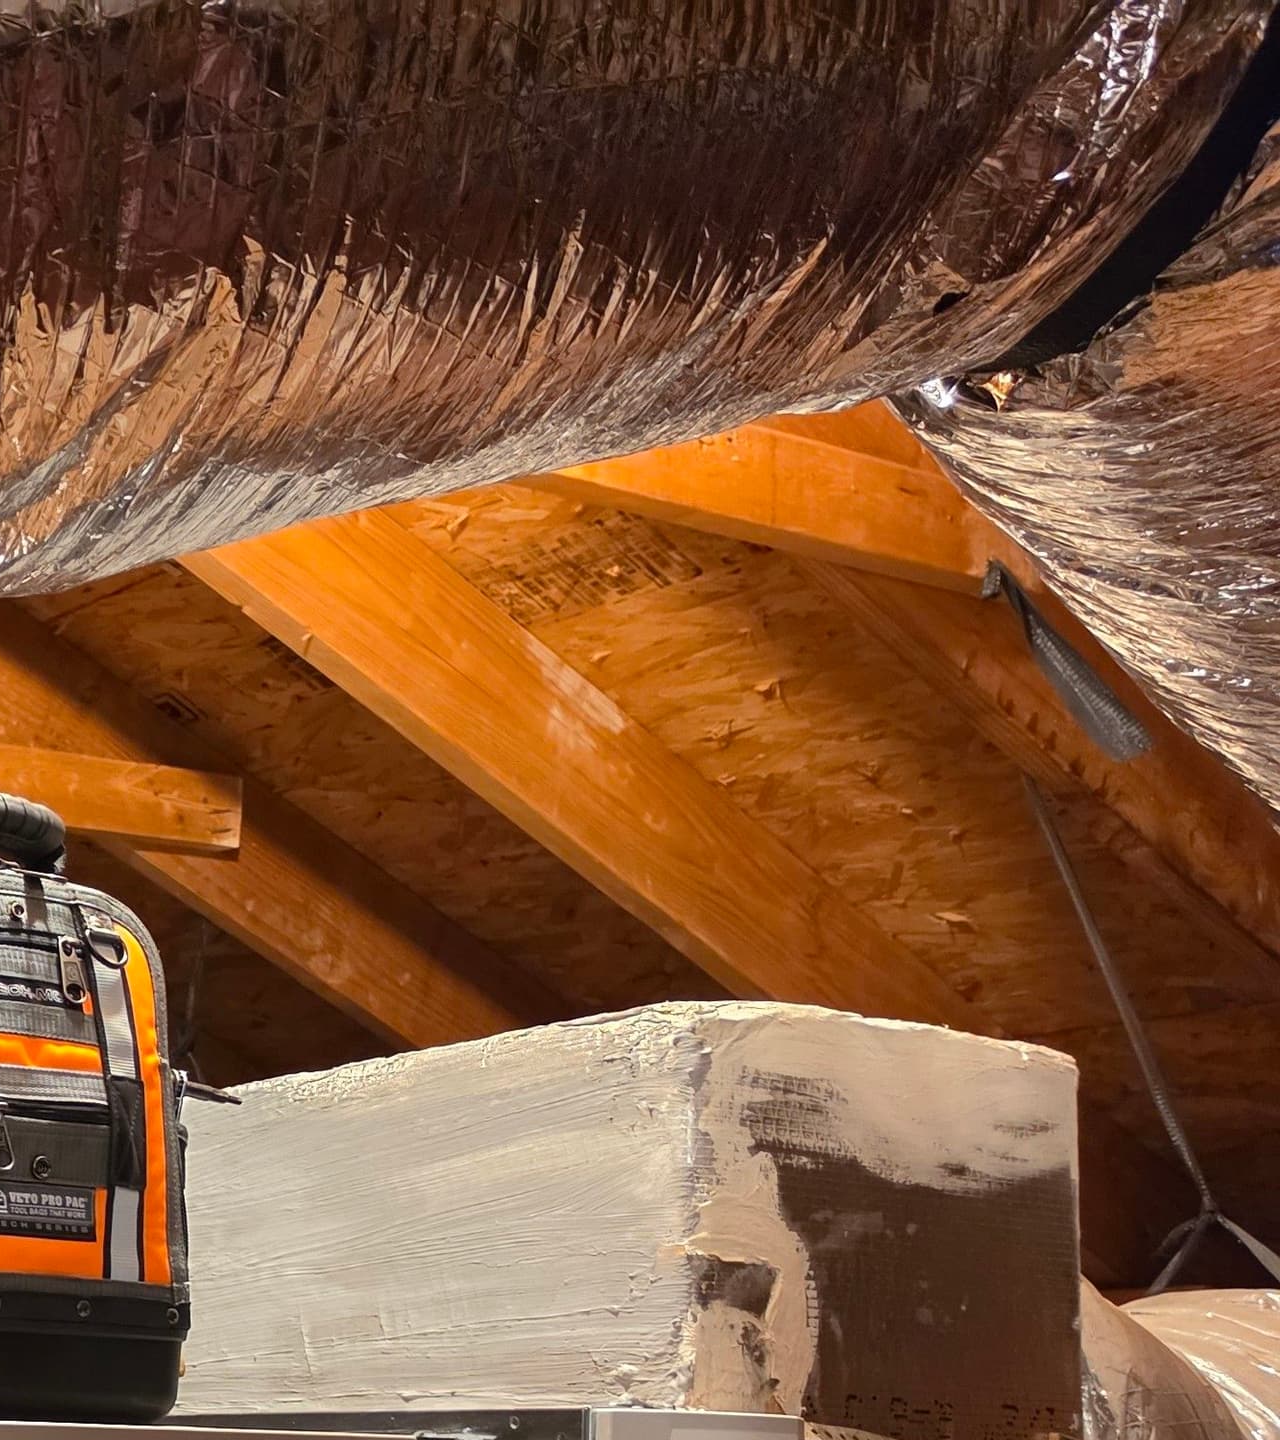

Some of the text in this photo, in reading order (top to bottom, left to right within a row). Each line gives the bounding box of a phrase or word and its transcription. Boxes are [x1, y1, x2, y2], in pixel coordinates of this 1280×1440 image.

[9, 1191, 86, 1209] VETO PRO PAC
[10, 1207, 28, 1215] TOOL
[30, 1208, 49, 1216] BAGS
[35, 1223, 89, 1233] SERIES
